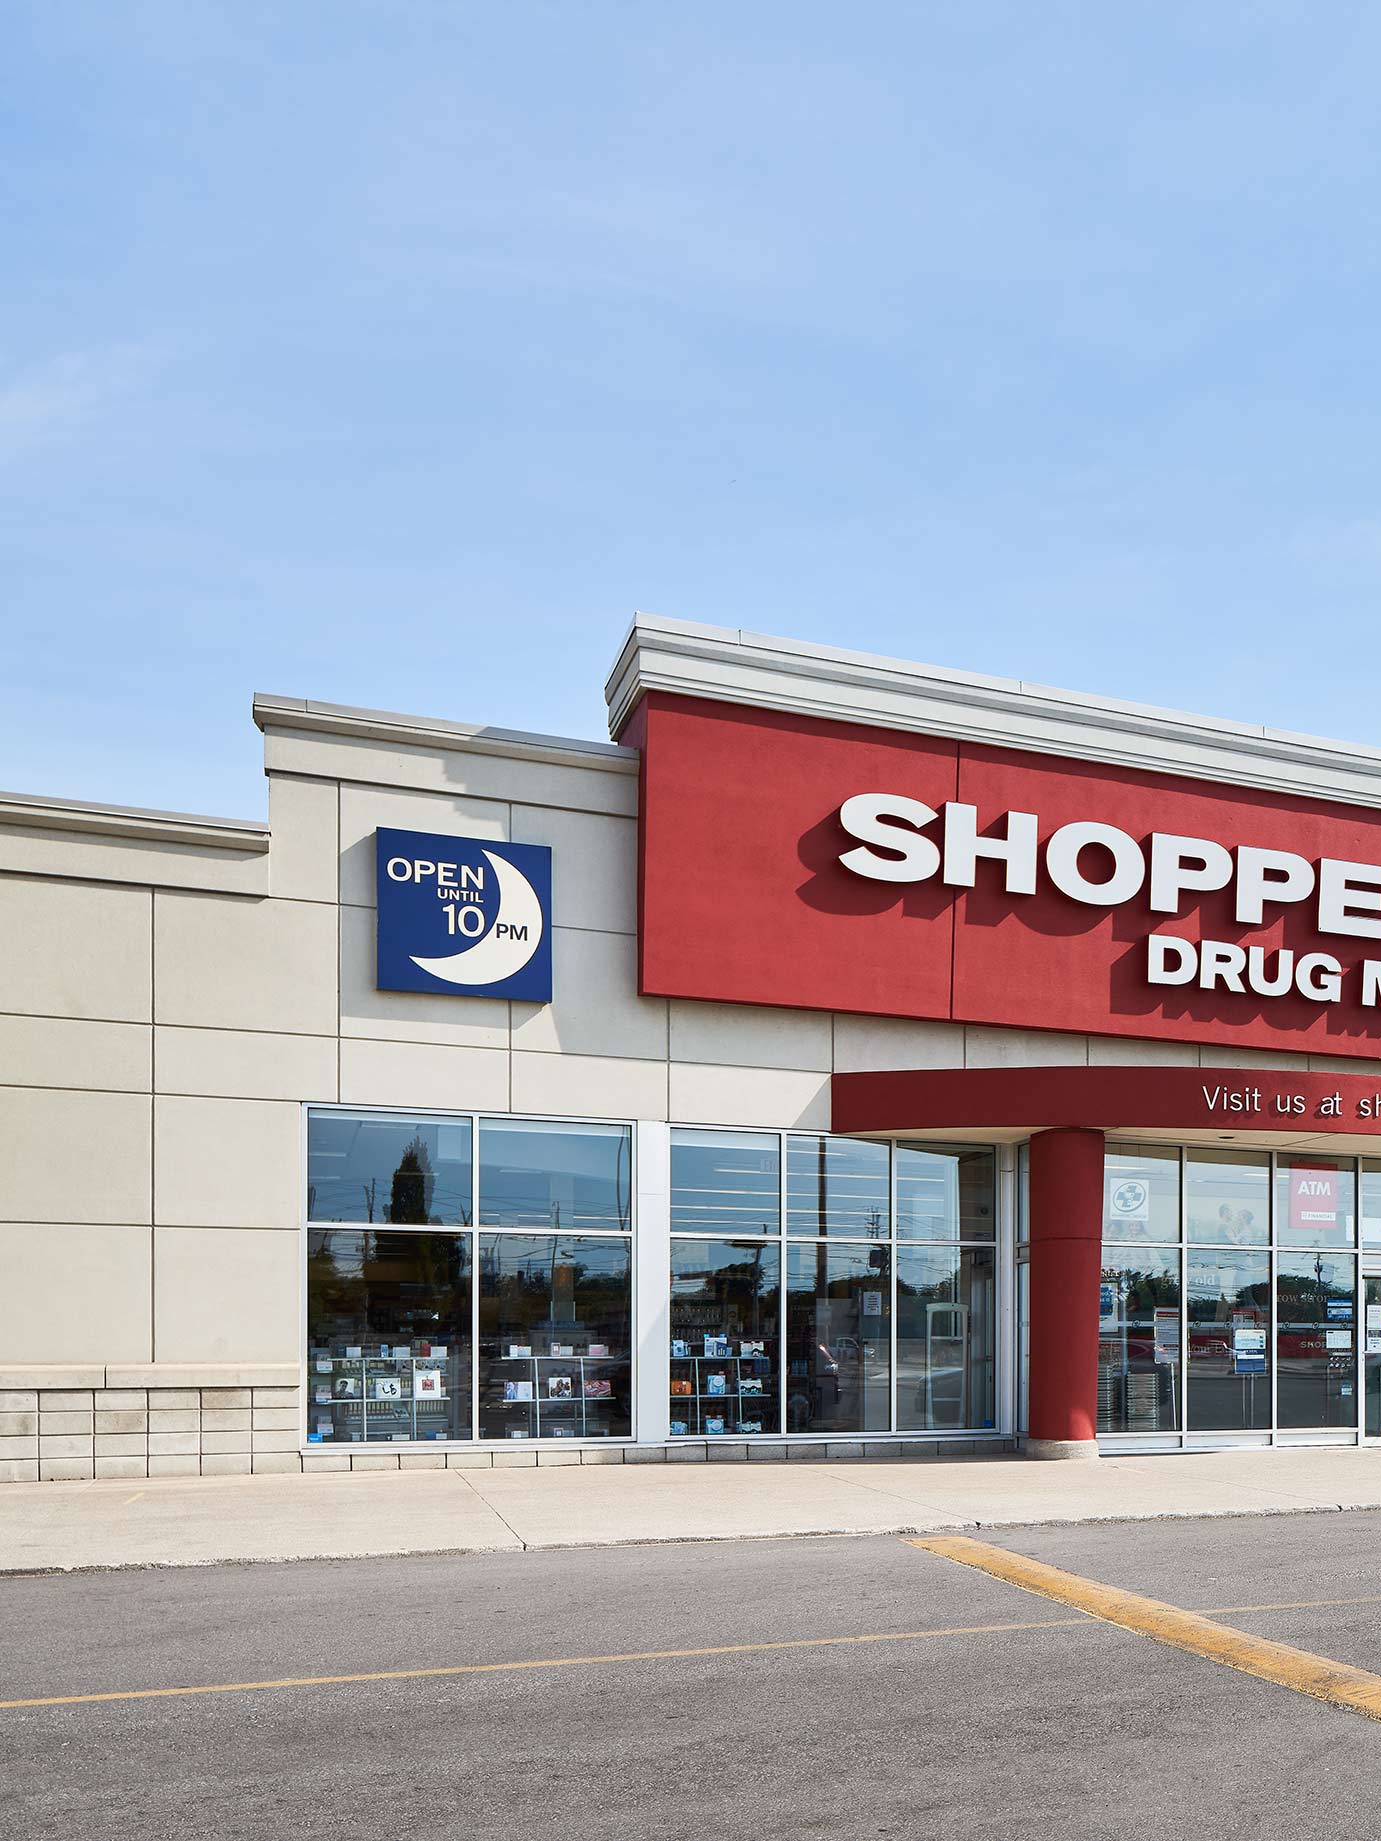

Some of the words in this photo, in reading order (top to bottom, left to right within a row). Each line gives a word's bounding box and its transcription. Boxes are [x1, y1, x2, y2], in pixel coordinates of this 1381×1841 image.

[386, 857, 484, 890] OPEN
[437, 887, 484, 903] UNTIL
[442, 903, 486, 938] 10
[495, 922, 529, 942] PM
[1147, 934, 1342, 1003] DRUG
[1202, 1085, 1262, 1113] Visit
[1276, 1093, 1306, 1115] us
[1320, 1091, 1344, 1116] at
[1297, 1181, 1331, 1196] ATM
